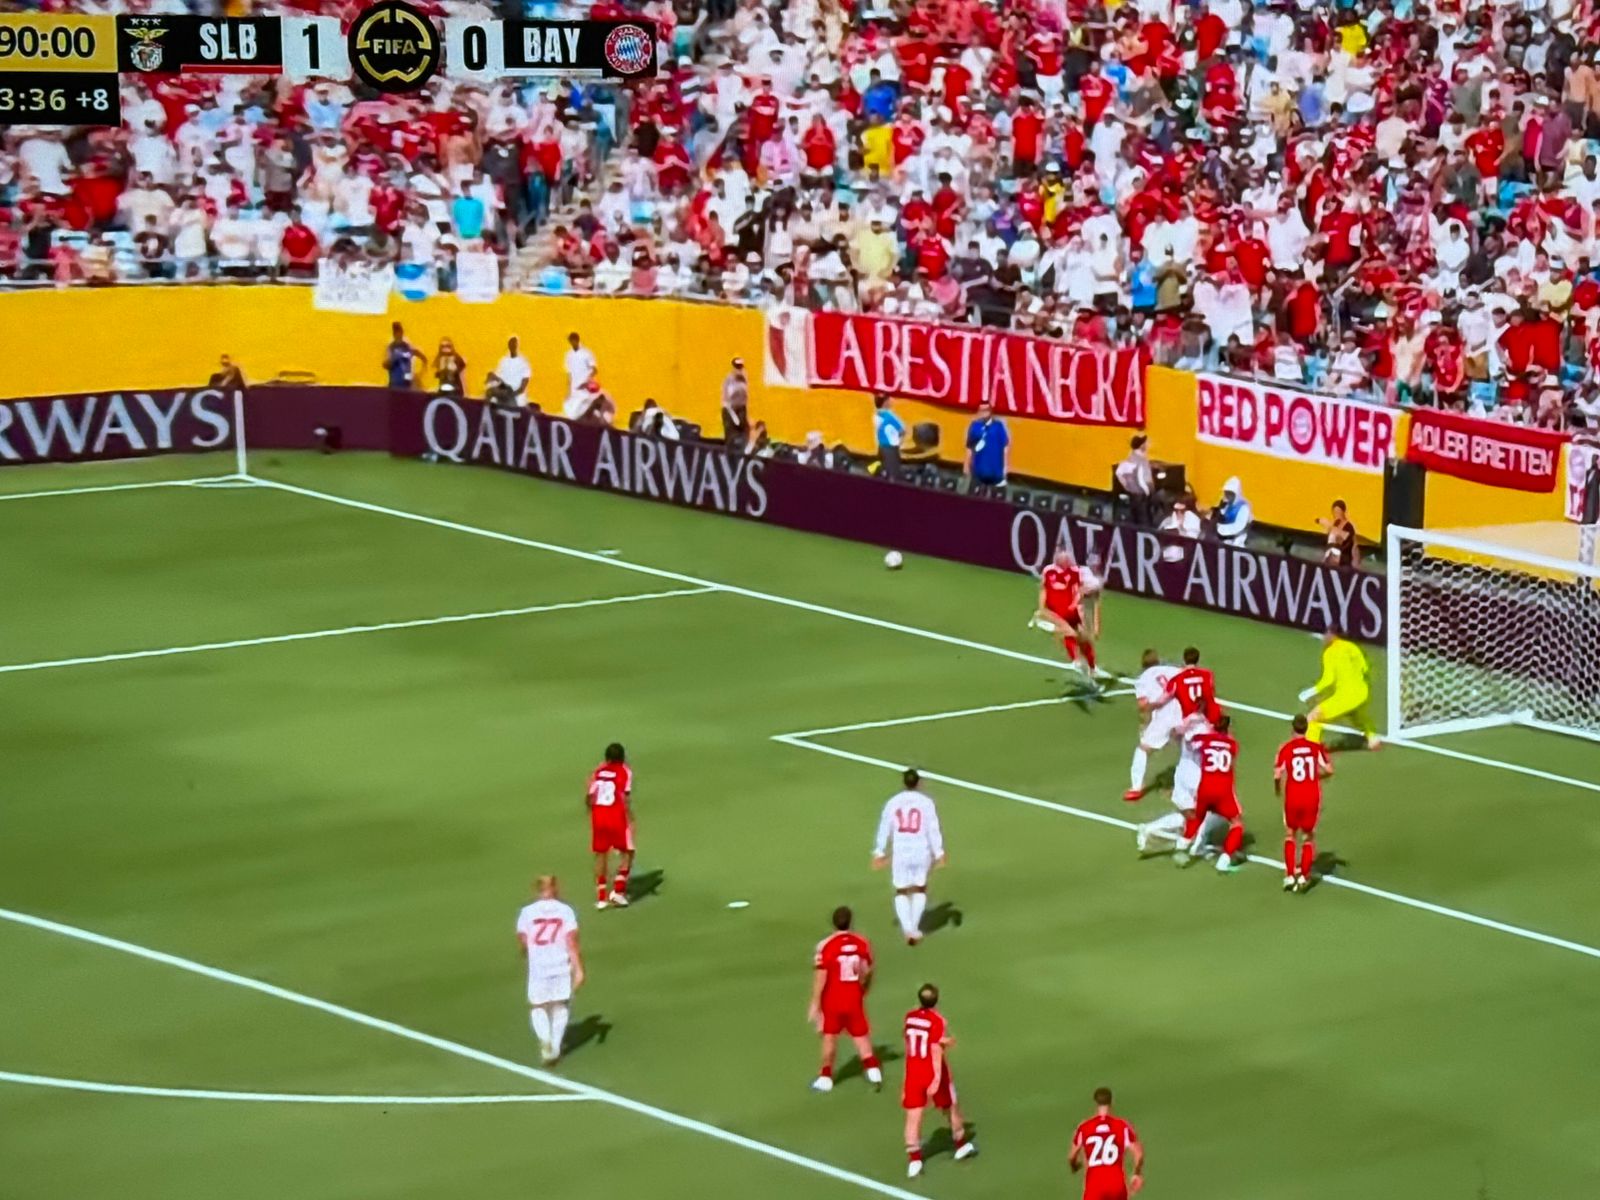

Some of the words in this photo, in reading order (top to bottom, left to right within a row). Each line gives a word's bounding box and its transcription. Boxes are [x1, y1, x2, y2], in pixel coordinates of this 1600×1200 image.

[0, 26, 95, 58] 90:00
[200, 23, 257, 60] SLB
[302, 25, 321, 70] 1
[373, 39, 417, 55] FIFA
[463, 25, 489, 71] 0
[523, 27, 582, 63] BAY
[75, 88, 109, 111] +8
[808, 314, 870, 388] LA
[874, 320, 1017, 412] BESTIA
[1025, 340, 1144, 423] NEGRA
[1198, 378, 1257, 442] RED
[1264, 391, 1393, 468] POWER
[423, 397, 577, 481] QATAR
[592, 431, 767, 517] AIRWAYS
[1411, 421, 1468, 460] ADLER
[1470, 435, 1554, 477] BRETTEN
[1183, 542, 1383, 639] AIRWAYS
[1203, 747, 1232, 773] 30
[1291, 756, 1316, 782] 81
[894, 807, 922, 834] 10
[532, 917, 564, 946] 27
[1085, 1133, 1119, 1168] 26
